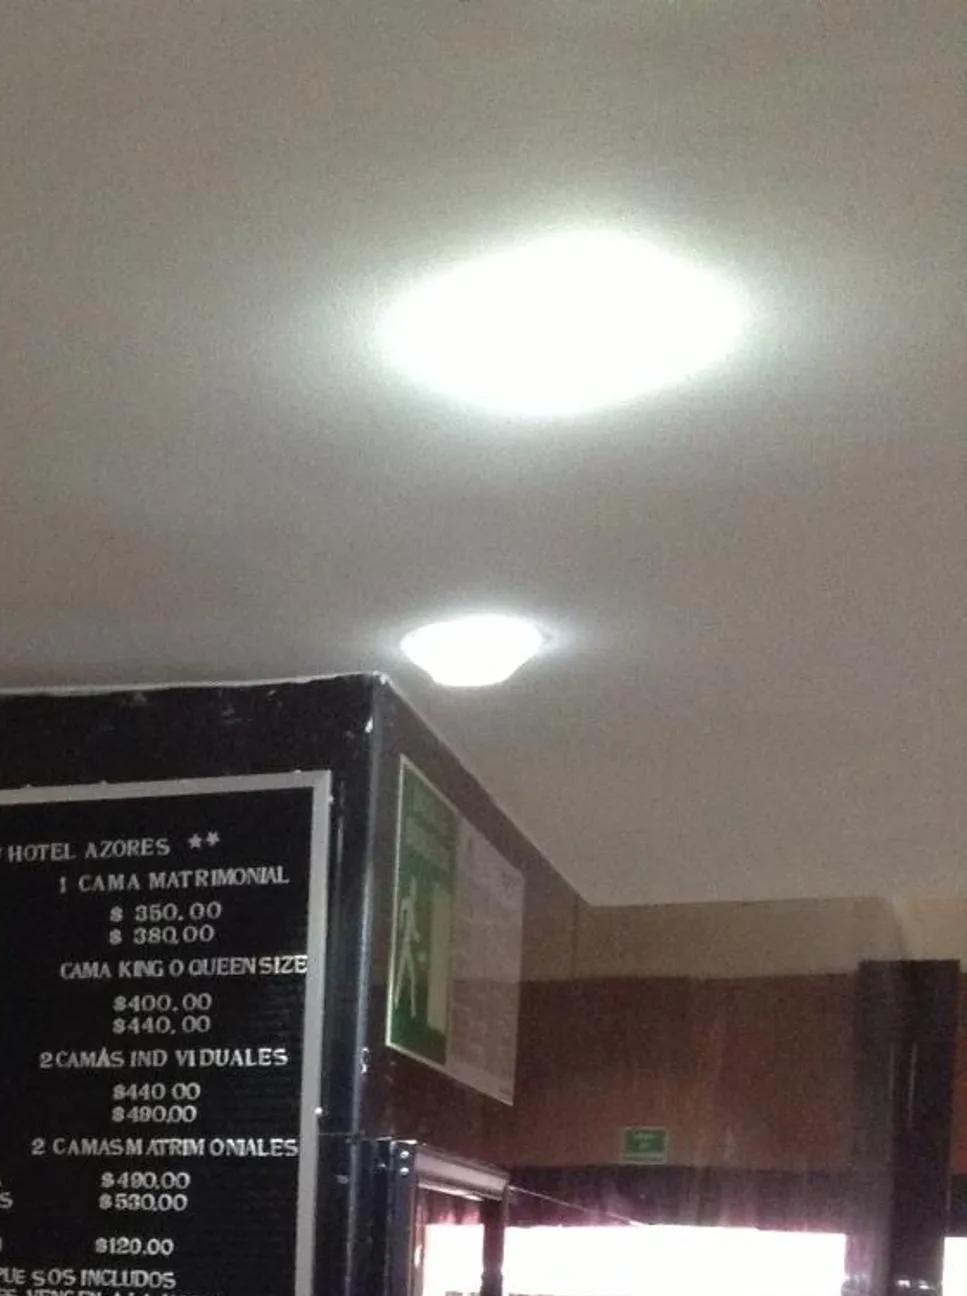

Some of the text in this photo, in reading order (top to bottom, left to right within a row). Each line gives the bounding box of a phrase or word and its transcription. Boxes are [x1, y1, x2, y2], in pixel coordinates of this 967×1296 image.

[8, 838, 171, 864] HOTEL AZORES
[78, 873, 141, 892] CAMA
[148, 866, 290, 890] MATRIMONIAL
[60, 954, 308, 979] CAMA KING O QUEEN SIZE
[32, 1137, 45, 1156] 2
[53, 1137, 123, 1156] CAMAS
